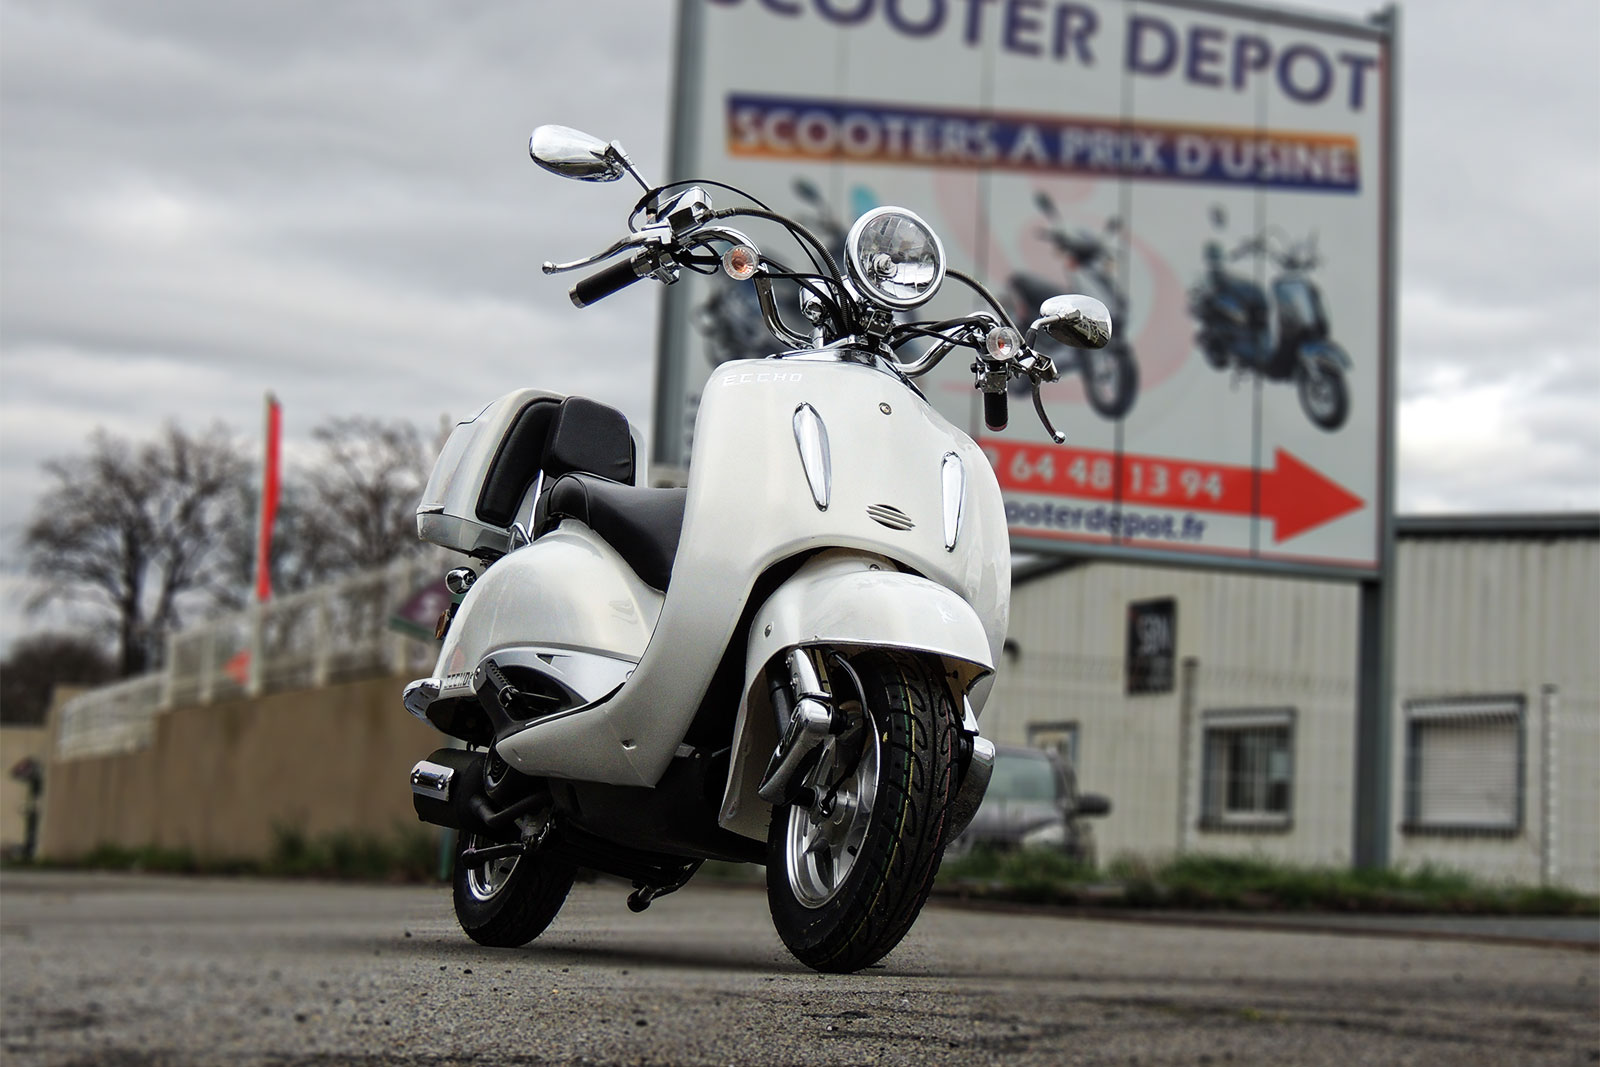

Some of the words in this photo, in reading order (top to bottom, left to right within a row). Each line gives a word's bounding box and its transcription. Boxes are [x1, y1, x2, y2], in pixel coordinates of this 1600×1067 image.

[708, 0, 1099, 67] OTER
[1124, 14, 1379, 112] DEPOT
[734, 105, 999, 165] SCOOTERS
[1009, 125, 1048, 167] A
[1060, 127, 1167, 171] PRIX
[1175, 136, 1356, 184] D'USINE
[722, 372, 803, 387] ECCHO
[1009, 447, 1055, 485] 64
[1067, 455, 1111, 492] 48
[1130, 462, 1169, 497] 13
[1179, 468, 1223, 503] 94
